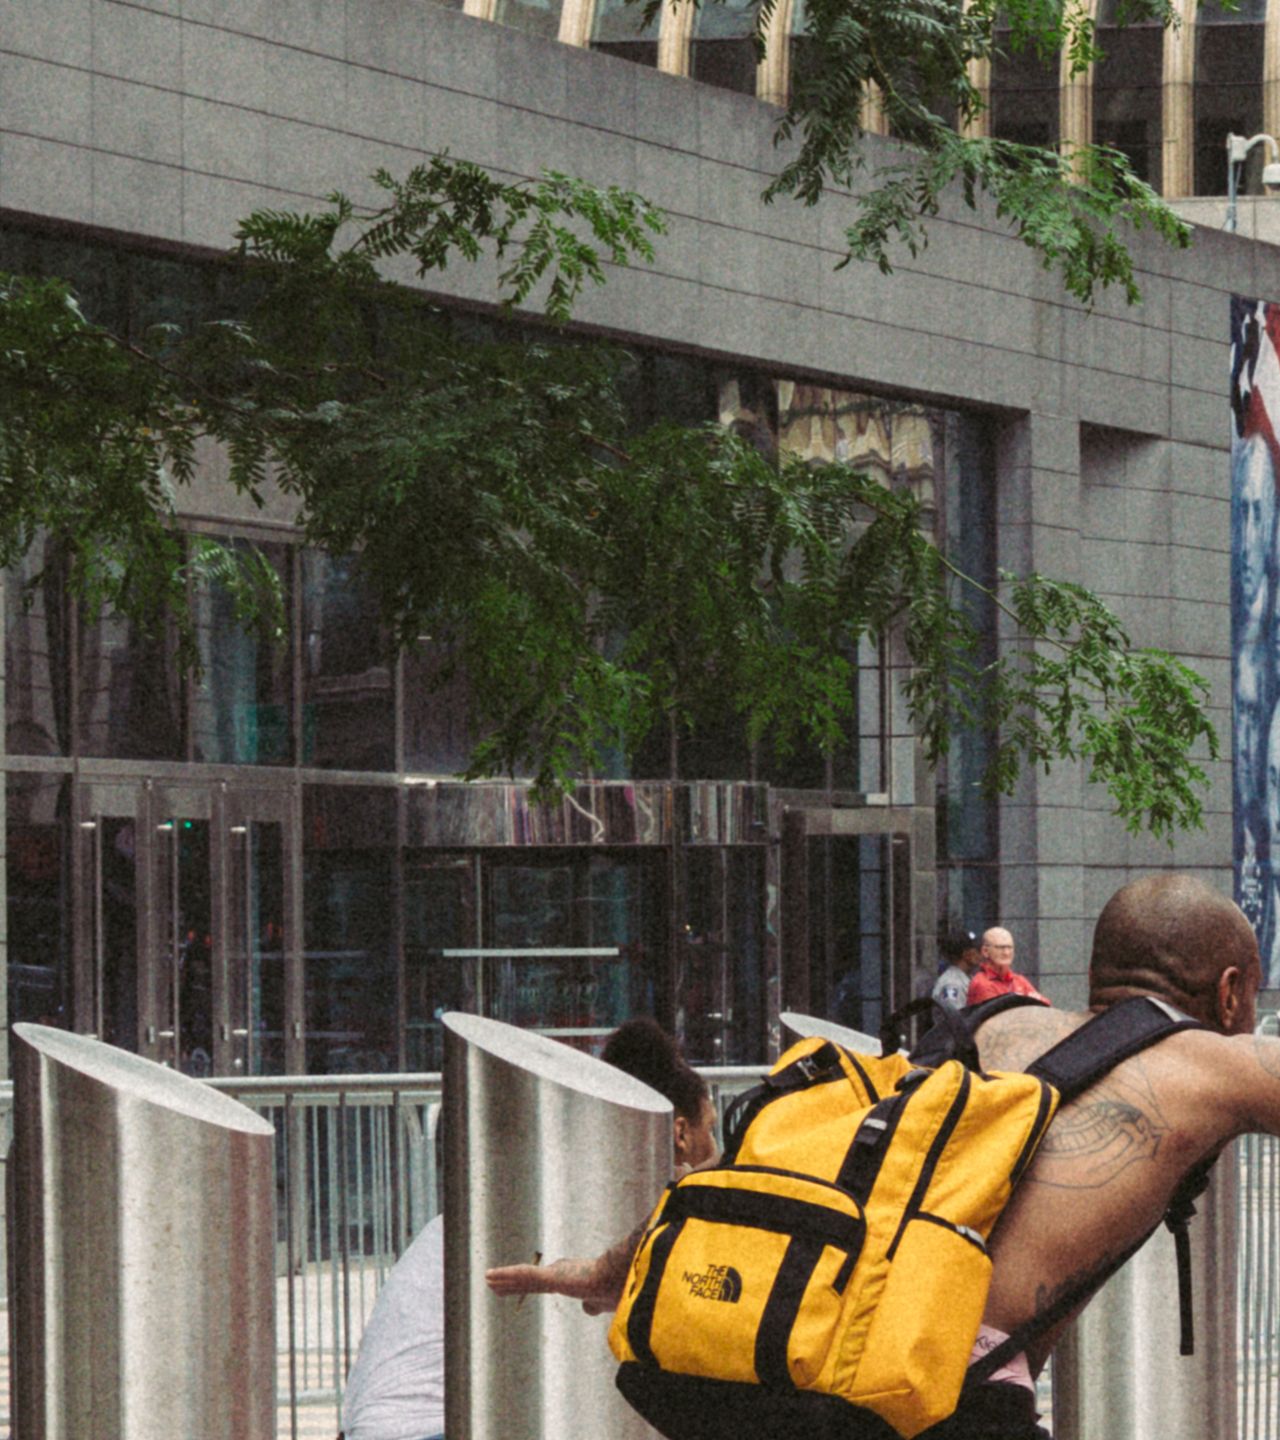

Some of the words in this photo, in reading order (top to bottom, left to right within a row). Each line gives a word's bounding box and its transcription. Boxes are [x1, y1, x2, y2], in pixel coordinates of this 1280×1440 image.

[681, 1270, 722, 1289] NORTH
[706, 1264, 728, 1278] THE
[689, 1283, 720, 1301] FACE
